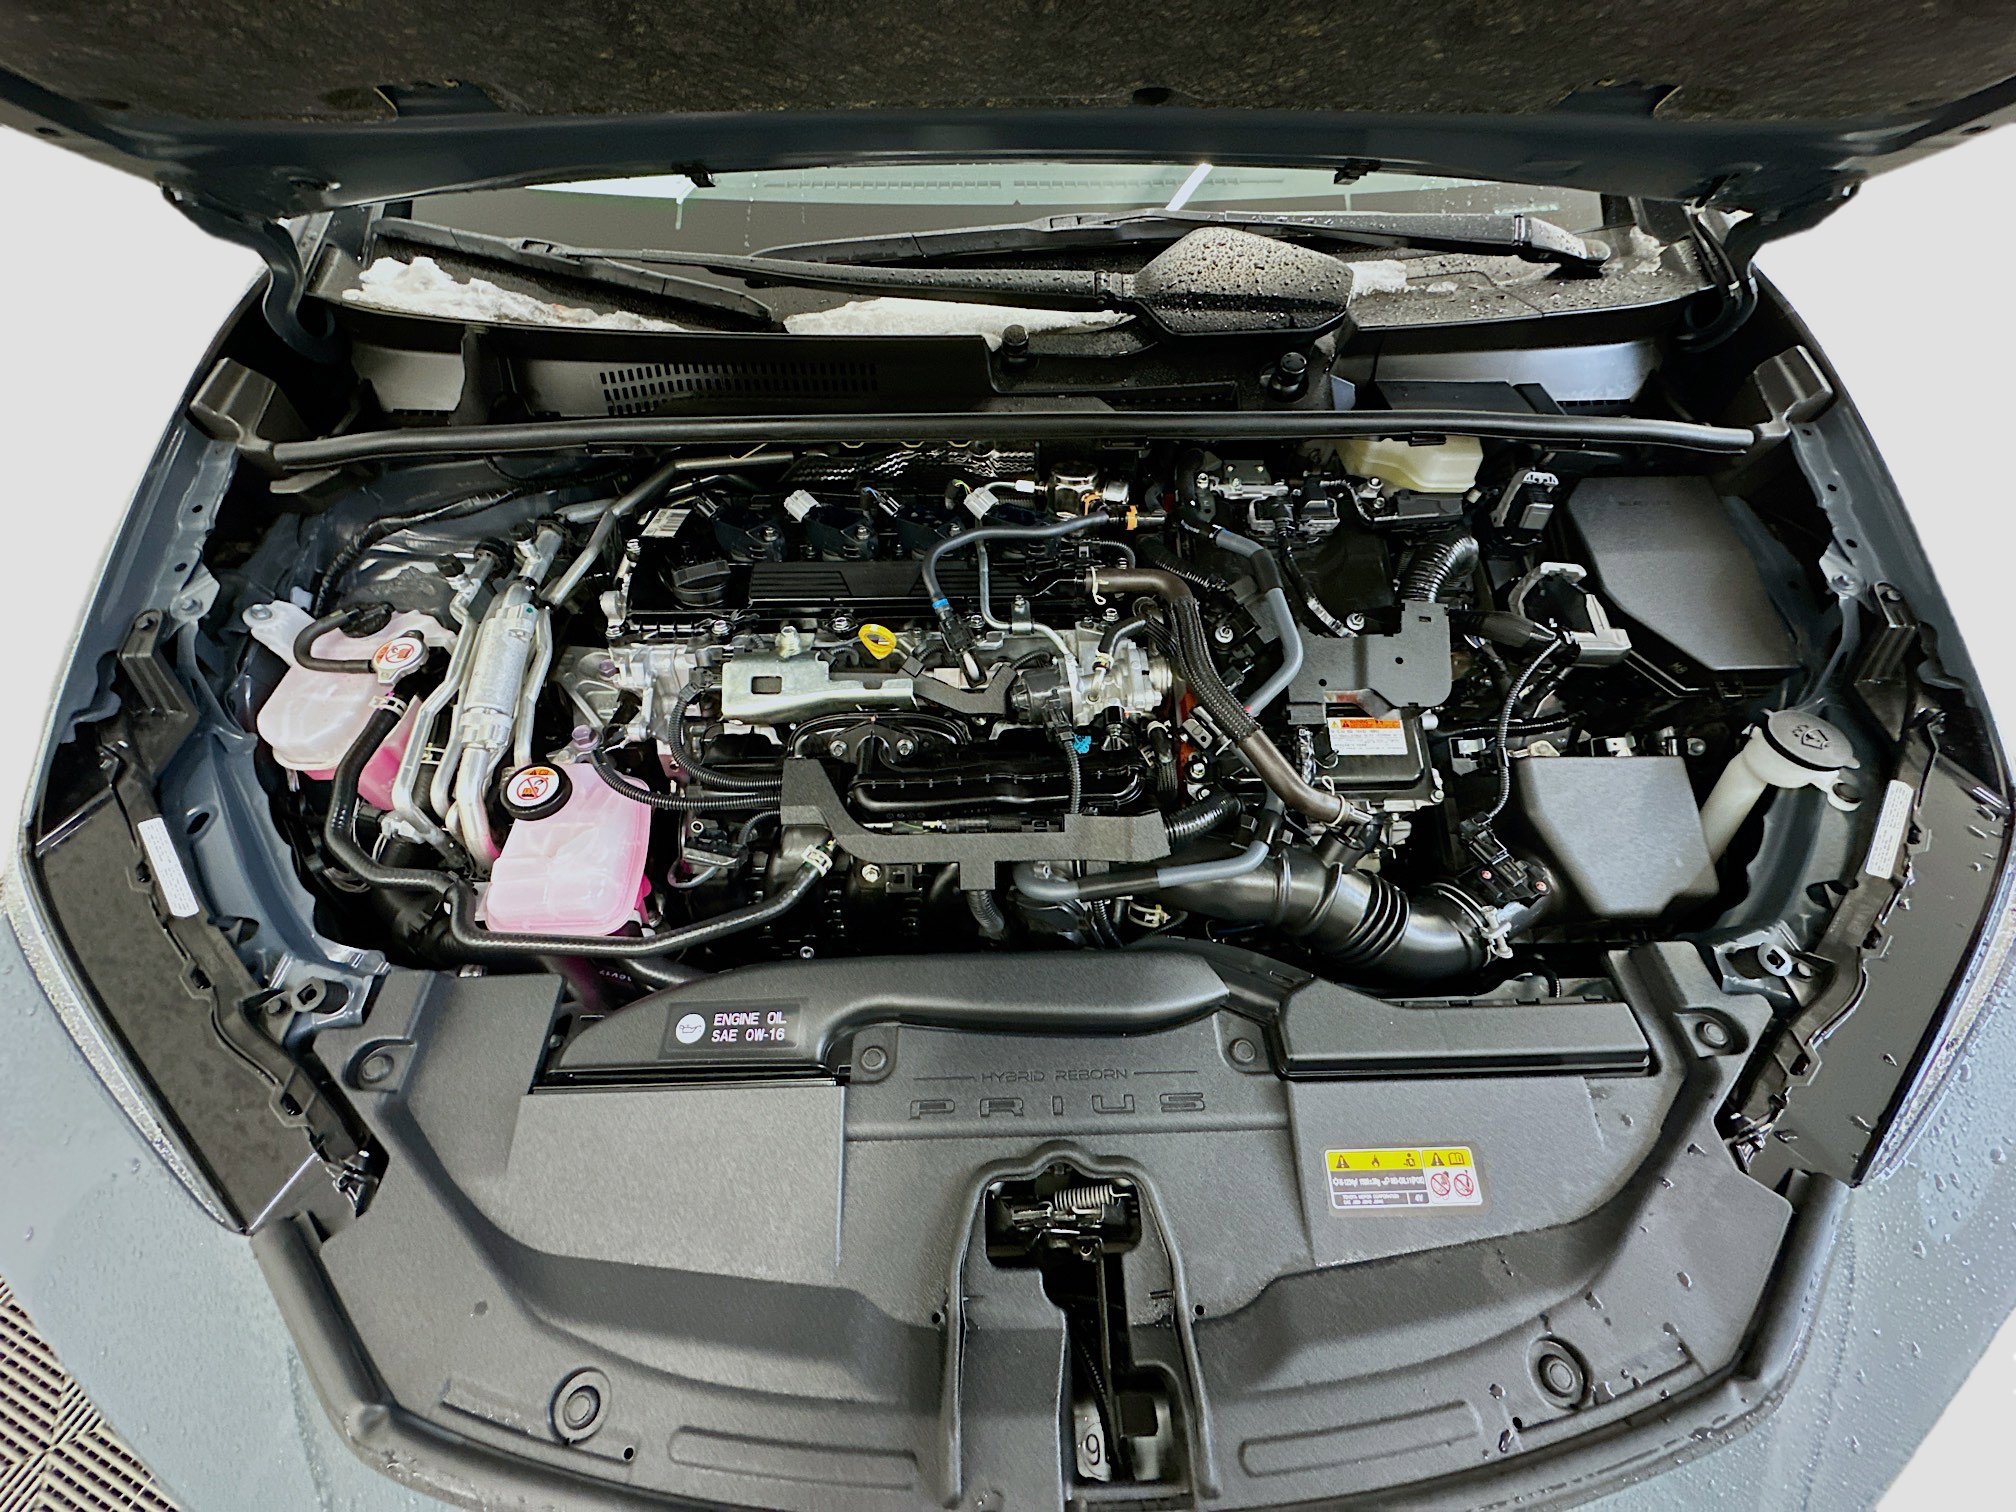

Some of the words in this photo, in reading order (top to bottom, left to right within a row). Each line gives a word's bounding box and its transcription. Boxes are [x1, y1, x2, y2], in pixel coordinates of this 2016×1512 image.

[713, 1011, 761, 1026] ENGINE
[767, 1011, 787, 1025] OIL
[711, 1028, 739, 1042] SAE
[981, 1070, 1046, 1083] HYBRID
[1055, 1068, 1128, 1082] REBORN
[909, 1092, 1206, 1120] PRIUS
